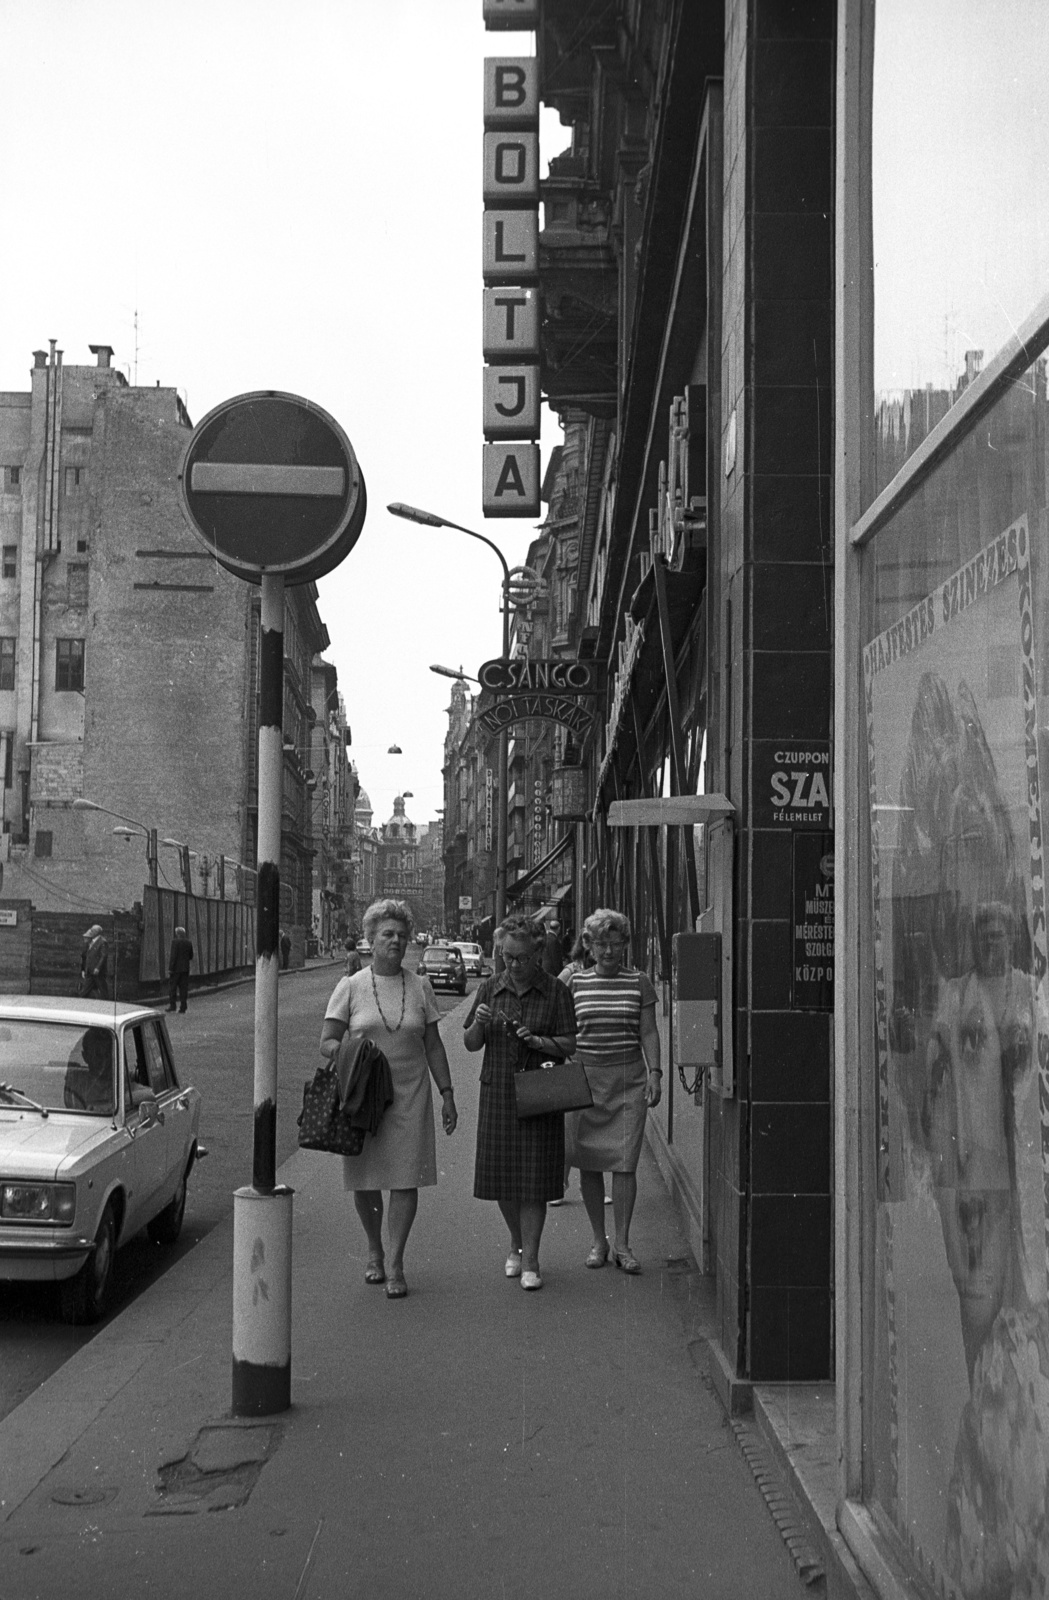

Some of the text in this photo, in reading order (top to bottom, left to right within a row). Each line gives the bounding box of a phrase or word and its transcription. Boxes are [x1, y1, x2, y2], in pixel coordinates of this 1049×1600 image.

[494, 65, 528, 498] BOLTJA
[774, 751, 829, 764] CZUPPON
[770, 771, 830, 807] SZA
[773, 808, 823, 821] FÉLEMELET
